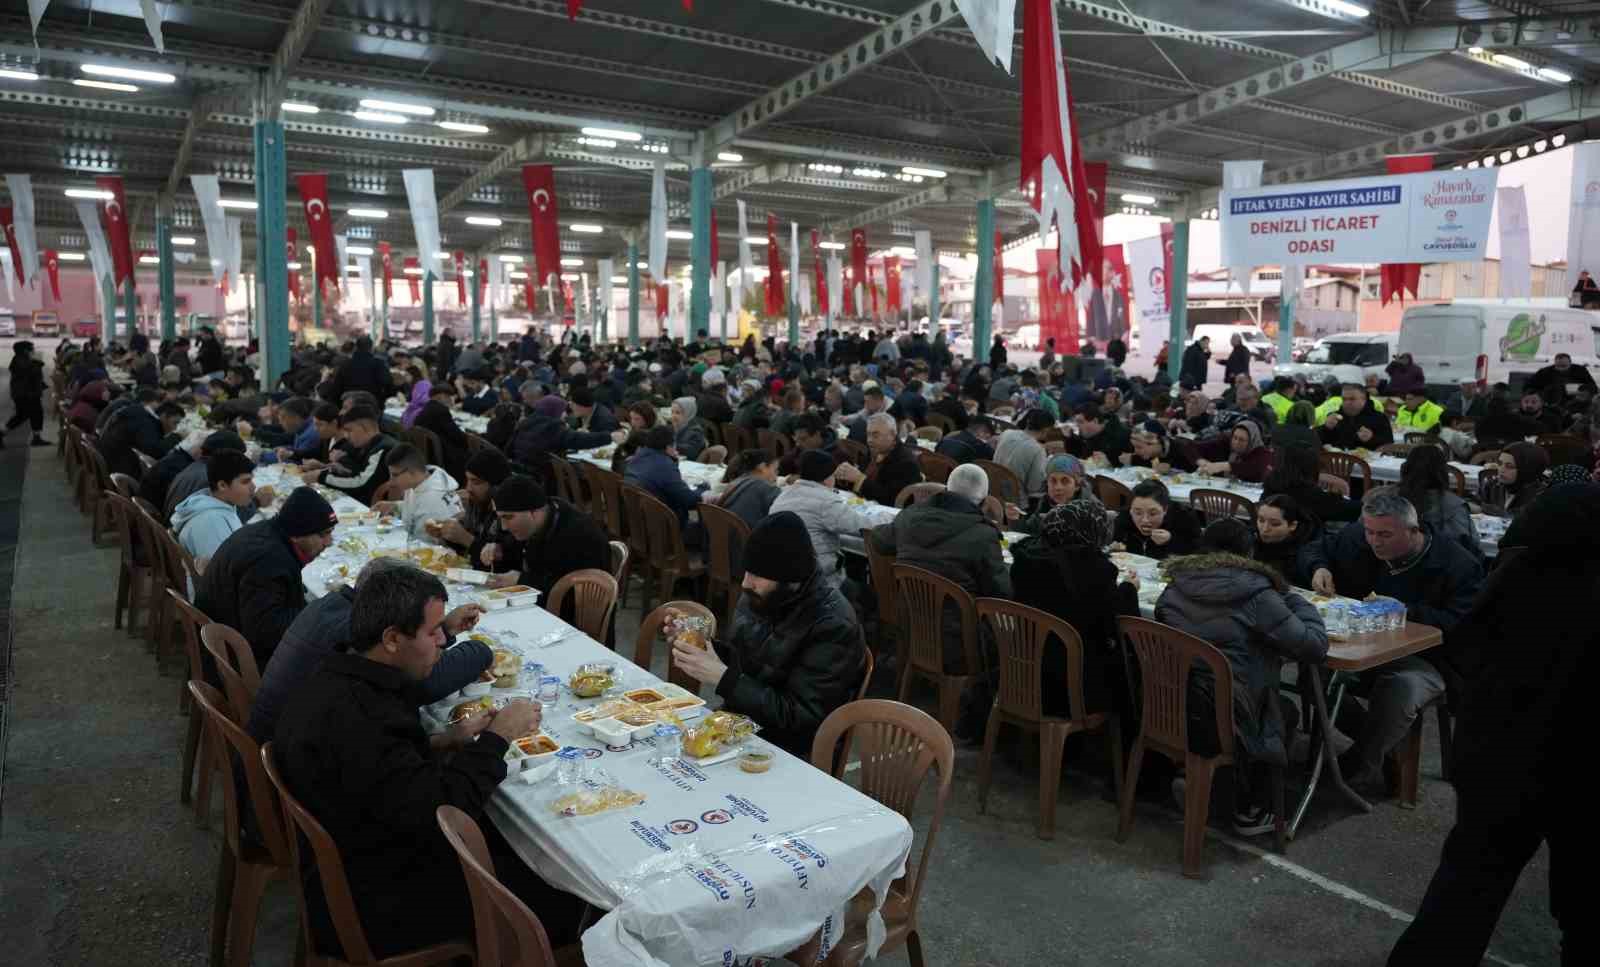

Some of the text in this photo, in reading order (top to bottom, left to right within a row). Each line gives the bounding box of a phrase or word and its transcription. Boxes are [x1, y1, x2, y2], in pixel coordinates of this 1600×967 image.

[1267, 196, 1305, 210] VEREN
[1308, 191, 1349, 207] HAYIR
[1350, 186, 1397, 205] SAHİBİ
[1250, 214, 1380, 235] DENİZLİ TİCARET
[1287, 238, 1335, 254] ODASI
